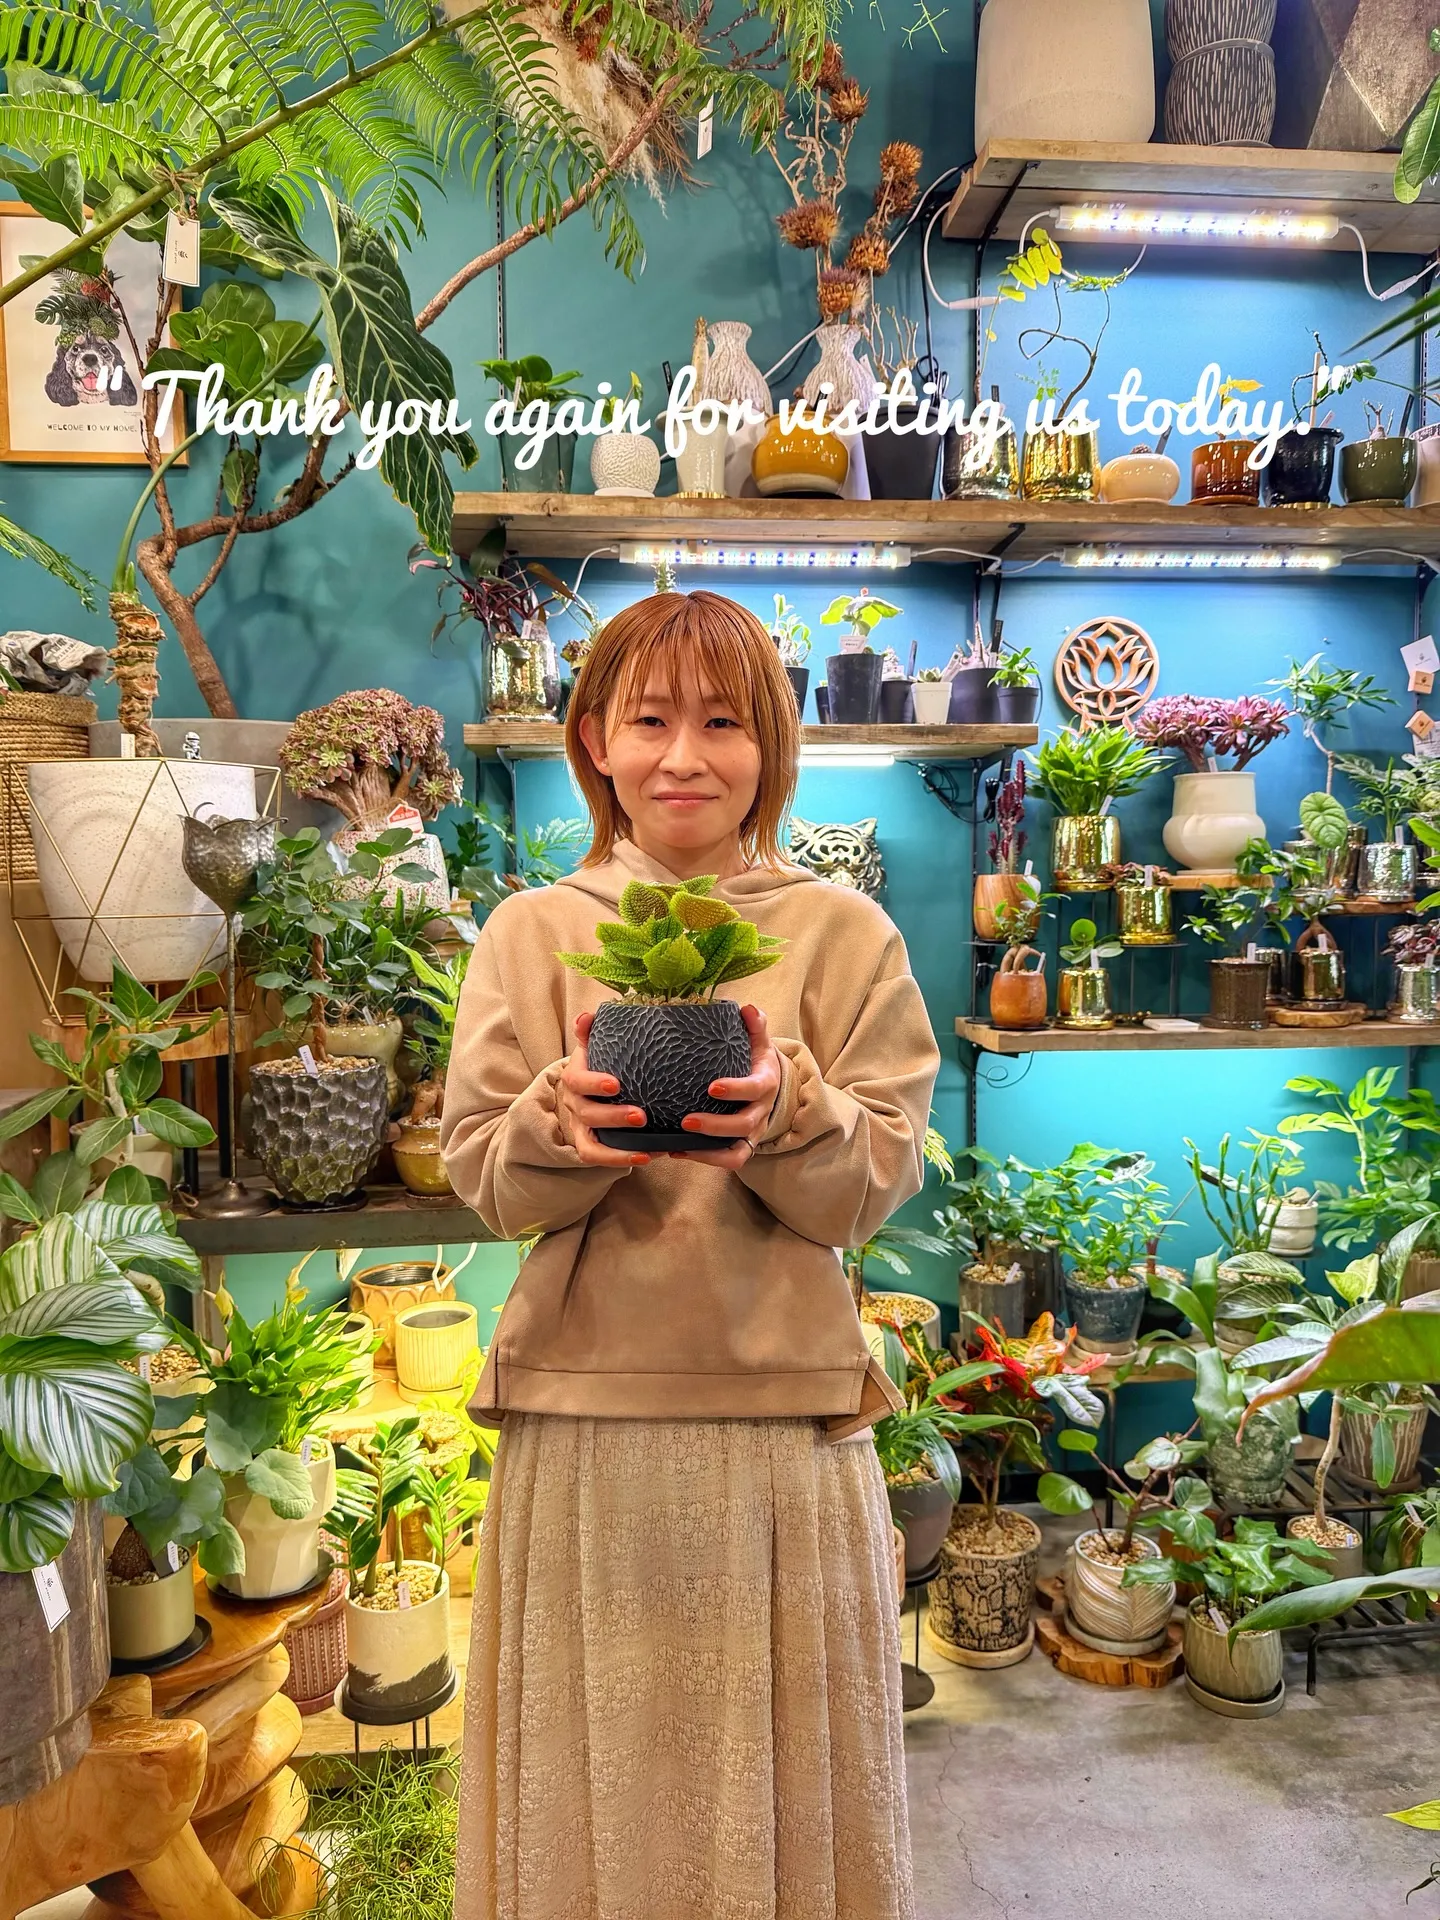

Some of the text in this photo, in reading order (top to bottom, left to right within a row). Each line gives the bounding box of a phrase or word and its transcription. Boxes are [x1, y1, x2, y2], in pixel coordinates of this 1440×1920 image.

[47, 423, 84, 432] WELCOME
[87, 424, 97, 432] TO
[113, 425, 138, 433] HOME.
